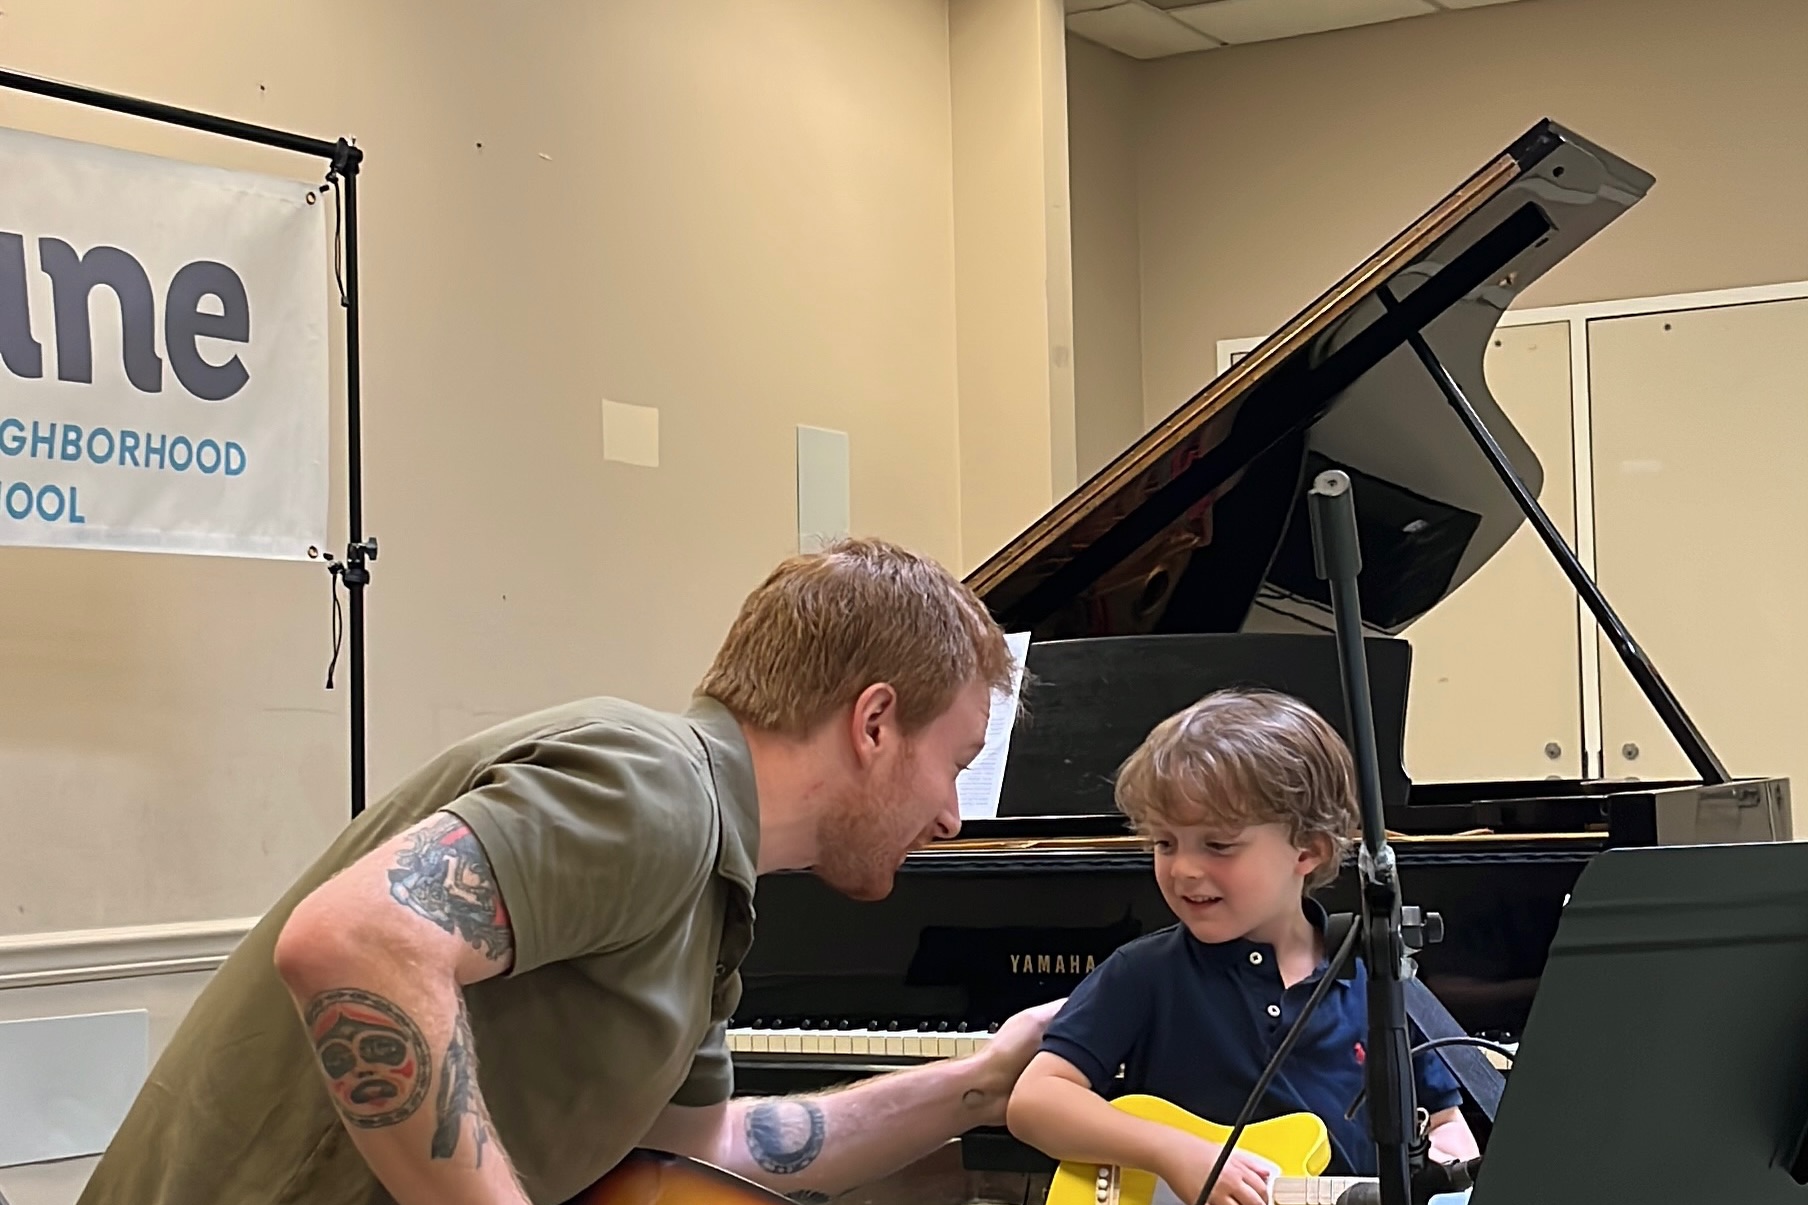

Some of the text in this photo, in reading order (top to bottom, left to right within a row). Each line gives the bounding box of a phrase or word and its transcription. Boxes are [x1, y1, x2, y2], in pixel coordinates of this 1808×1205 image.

[0, 418, 247, 476] GHBORHOOD
[0, 482, 85, 523] OOL
[1010, 954, 1095, 974] YAMAHA
